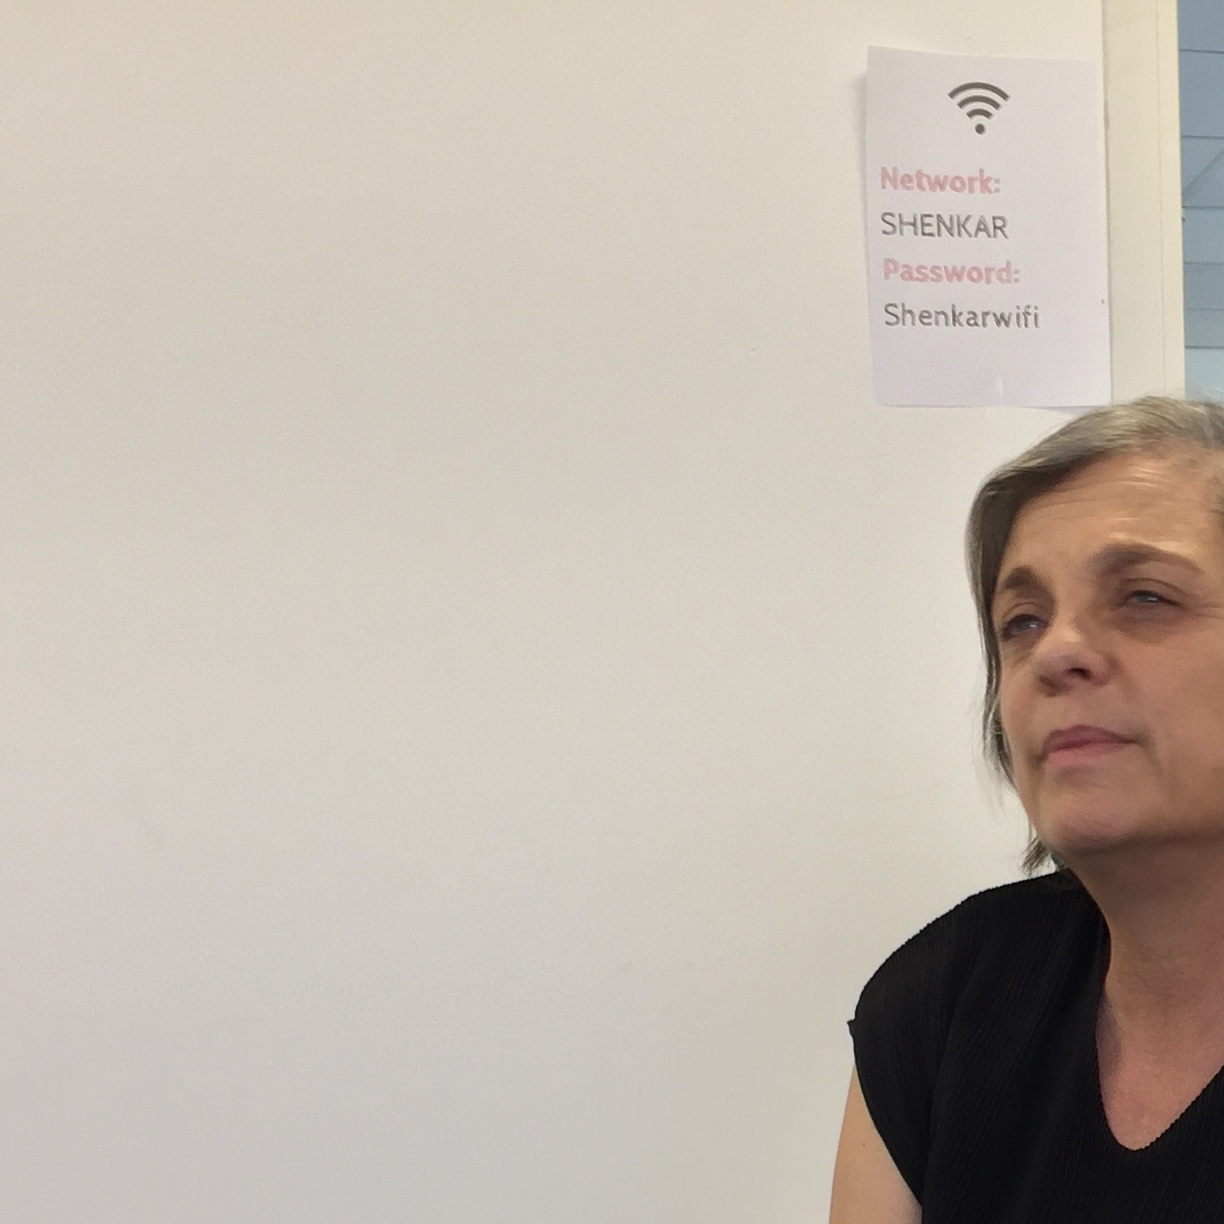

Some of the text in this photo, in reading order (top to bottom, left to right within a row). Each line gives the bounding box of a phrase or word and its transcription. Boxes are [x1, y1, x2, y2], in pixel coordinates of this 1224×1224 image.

[881, 166, 1001, 195] Network:
[880, 212, 1009, 239] SHENKAR
[883, 258, 1021, 285] Password:
[884, 303, 1040, 329] Shenkarwifi
